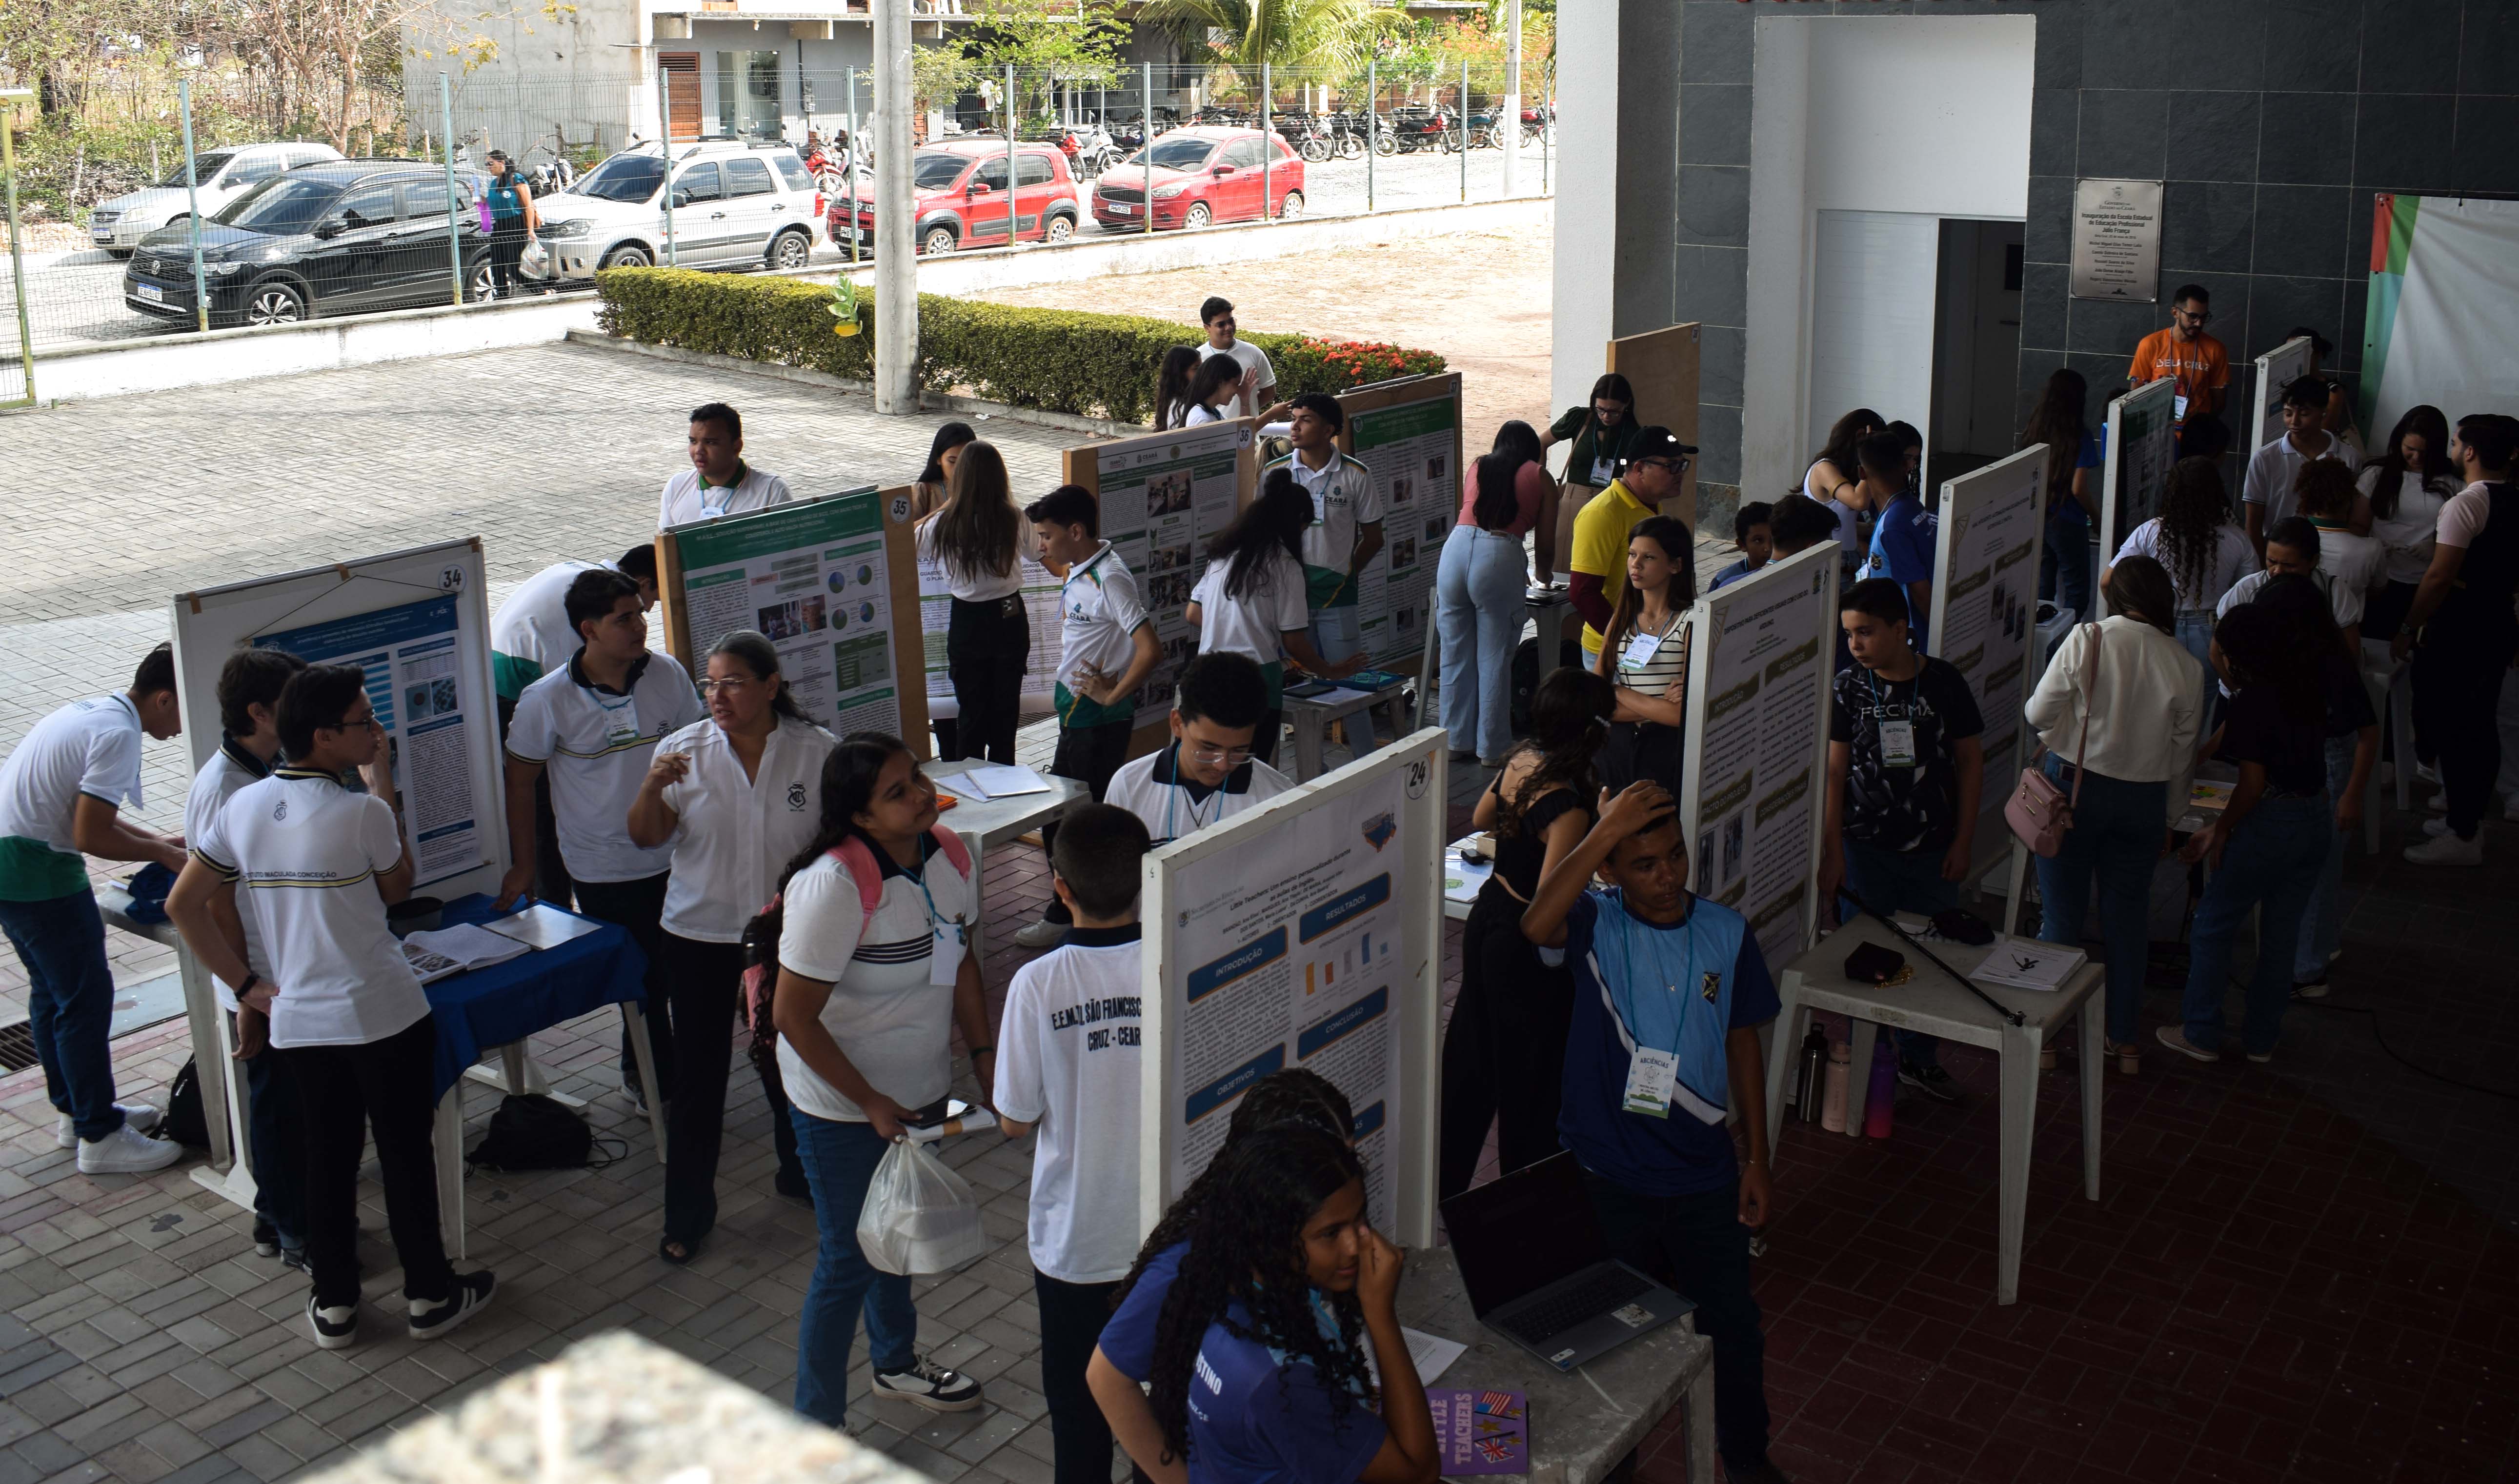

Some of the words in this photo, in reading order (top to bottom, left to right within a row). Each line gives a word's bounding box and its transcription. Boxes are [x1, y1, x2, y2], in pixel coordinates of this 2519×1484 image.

[1239, 429, 1249, 442] 36
[893, 501, 907, 515] 35
[443, 569, 462, 587] 34
[1779, 651, 1805, 671] RESULTADOS
[1714, 690, 1744, 712] INTRODUÇÃO
[1410, 762, 1427, 786] 24
[1230, 899, 1243, 910] Little
[1244, 885, 1270, 903] Teachers:
[1270, 881, 1279, 891] Um
[1280, 873, 1296, 886] ensino
[1298, 855, 1332, 879] personalizado
[1333, 846, 1350, 861] durante
[1277, 886, 1290, 898] aulas
[1291, 882, 1297, 891] de
[1325, 896, 1367, 922] RESULTADOS
[1215, 948, 1263, 978] INTRODUÇÃO
[1085, 998, 1101, 1023] SÃO
[1325, 1007, 1364, 1034] CONCLUSÃO
[1088, 1028, 1110, 1052] CRUZ
[1640, 1057, 1669, 1069] ABCIÊNCIAS
[1217, 1068, 1255, 1096] OBJETIVOS
[1431, 1399, 1448, 1453] LITTLE
[1455, 1393, 1472, 1464] TEACHERS
